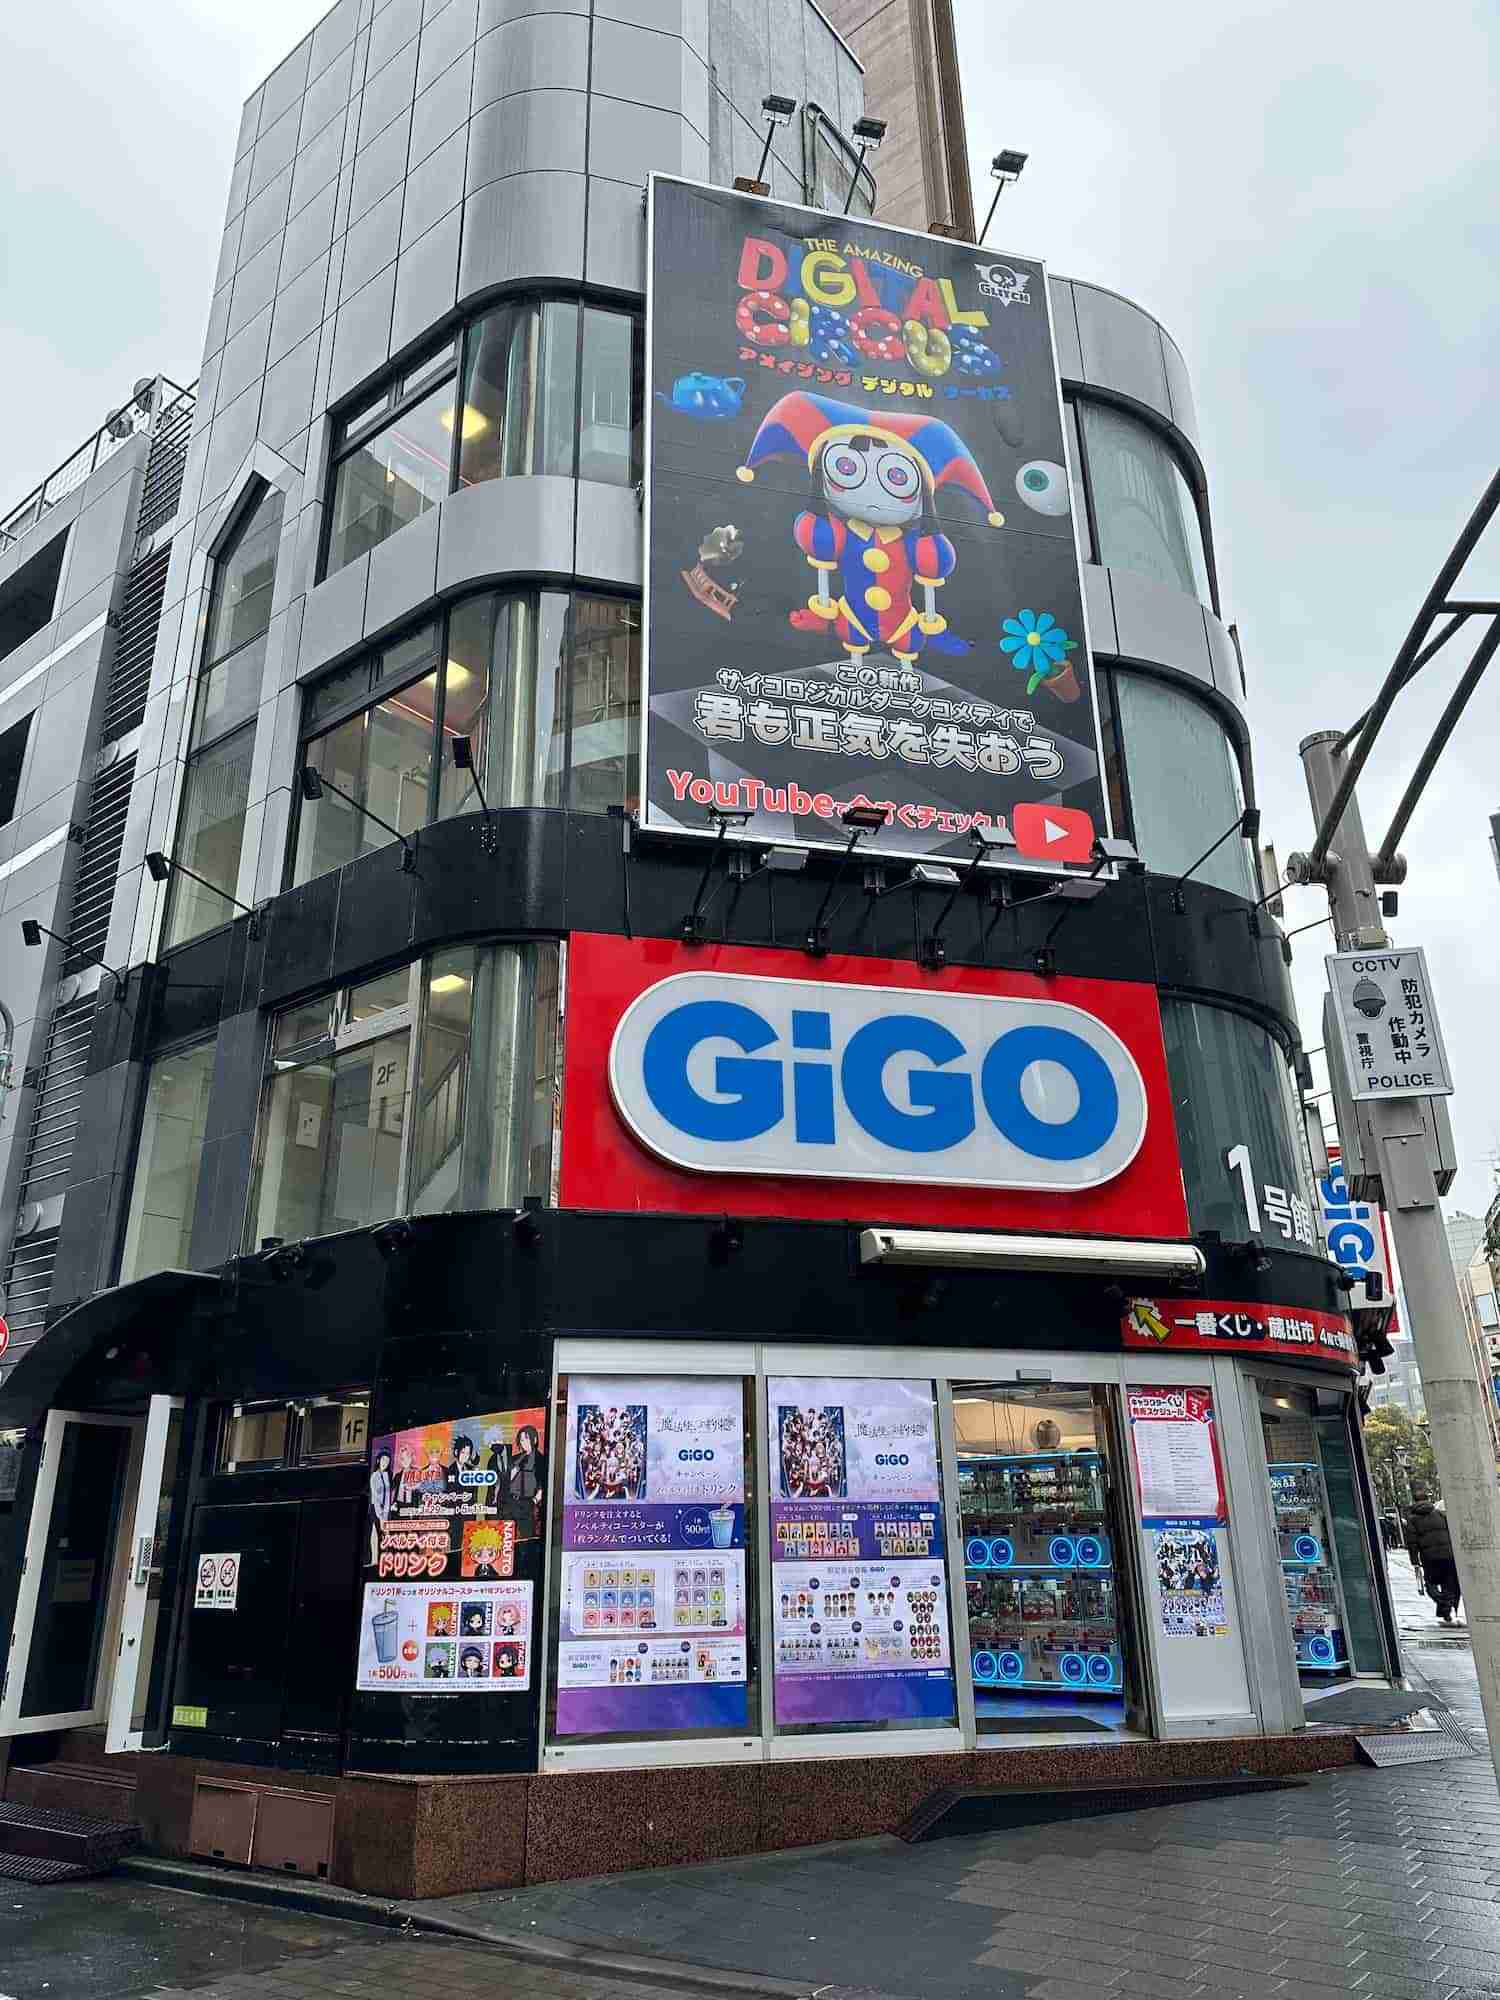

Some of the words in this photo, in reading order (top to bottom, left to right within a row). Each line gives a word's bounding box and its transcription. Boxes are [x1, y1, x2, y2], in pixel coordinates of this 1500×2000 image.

[805, 238, 838, 253] THE
[844, 244, 923, 278] AMAZING
[736, 291, 1001, 377] CIRCUS
[862, 376, 934, 399] デジタル
[837, 664, 922, 693] この新作
[717, 668, 1034, 732] サイコロジカルダークコメディで
[695, 691, 1065, 780] 君も正気を失おう
[1352, 958, 1401, 973] CCTV
[1401, 978, 1431, 1058] 防犯カメラ
[1356, 1032, 1375, 1070] 警視庁
[1389, 1016, 1412, 1065] 作動中
[376, 1062, 397, 1086] 2F
[642, 1000, 1119, 1161] GiGO
[1367, 1073, 1434, 1089] POLICE
[344, 1418, 364, 1445] 1F
[679, 1449, 714, 1461] GiGO
[875, 1454, 909, 1466] GiGO
[460, 1471, 497, 1485] GiGO
[502, 1520, 514, 1576] NARUTO
[379, 1551, 449, 1578] ドリンク
